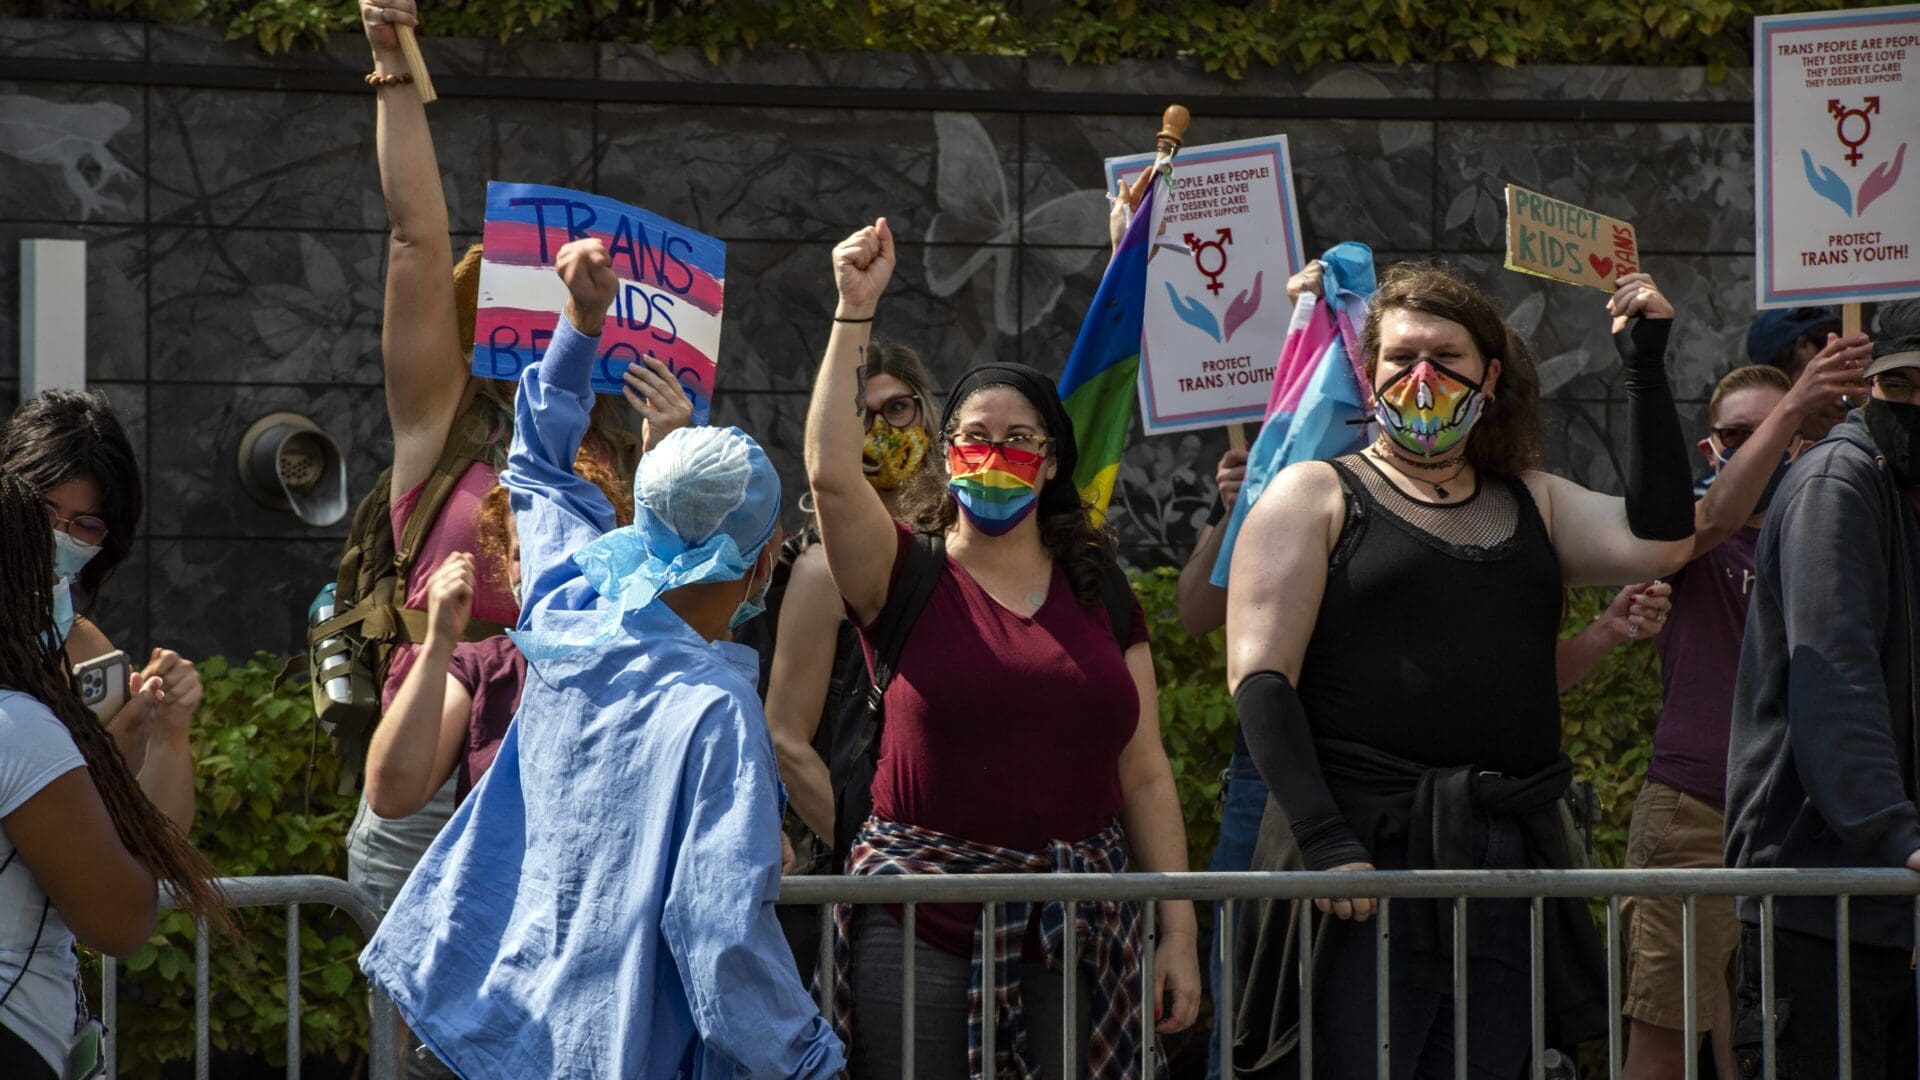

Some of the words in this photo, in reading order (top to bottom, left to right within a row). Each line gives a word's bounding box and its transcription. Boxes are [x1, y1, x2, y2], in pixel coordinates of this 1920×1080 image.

[1778, 43, 1814, 56] TRANS
[1817, 40, 1857, 53] PEOPLE
[1861, 38, 1883, 50] ARE
[1802, 56, 1826, 66] THEY
[1829, 52, 1873, 65] DESERVE
[1875, 50, 1906, 62] LOVE!
[1806, 68, 1828, 77] THEY
[1831, 64, 1871, 76] DESERVE
[1872, 62, 1901, 73] CARE!
[1805, 80, 1824, 88] THEY
[1827, 76, 1862, 87] DESERVE
[1863, 73, 1902, 84] SUPPORT!
[1206, 173, 1226, 185] ARE
[1228, 167, 1269, 182] PEOPLE!
[1179, 186, 1219, 201] DESERVE
[1221, 182, 1249, 195] LOVE!
[1164, 204, 1180, 214] HEY
[1182, 198, 1218, 211] DESERVE
[1220, 194, 1247, 206] CARE!
[1162, 214, 1178, 223] HEY
[1180, 209, 1212, 222] DESERVE
[1214, 205, 1249, 217] SUPPORT!
[1515, 189, 1601, 241] PROTECT
[509, 197, 694, 295] TRANS
[1829, 232, 1881, 247] PROTECT
[1519, 224, 1583, 274] KIDS
[1612, 223, 1638, 279] RANS
[1801, 250, 1849, 266] TRANS
[1853, 244, 1909, 262] YOUTH!
[602, 284, 678, 345] IDS
[1202, 355, 1251, 373] PROTECT
[1178, 374, 1224, 392] TRANS
